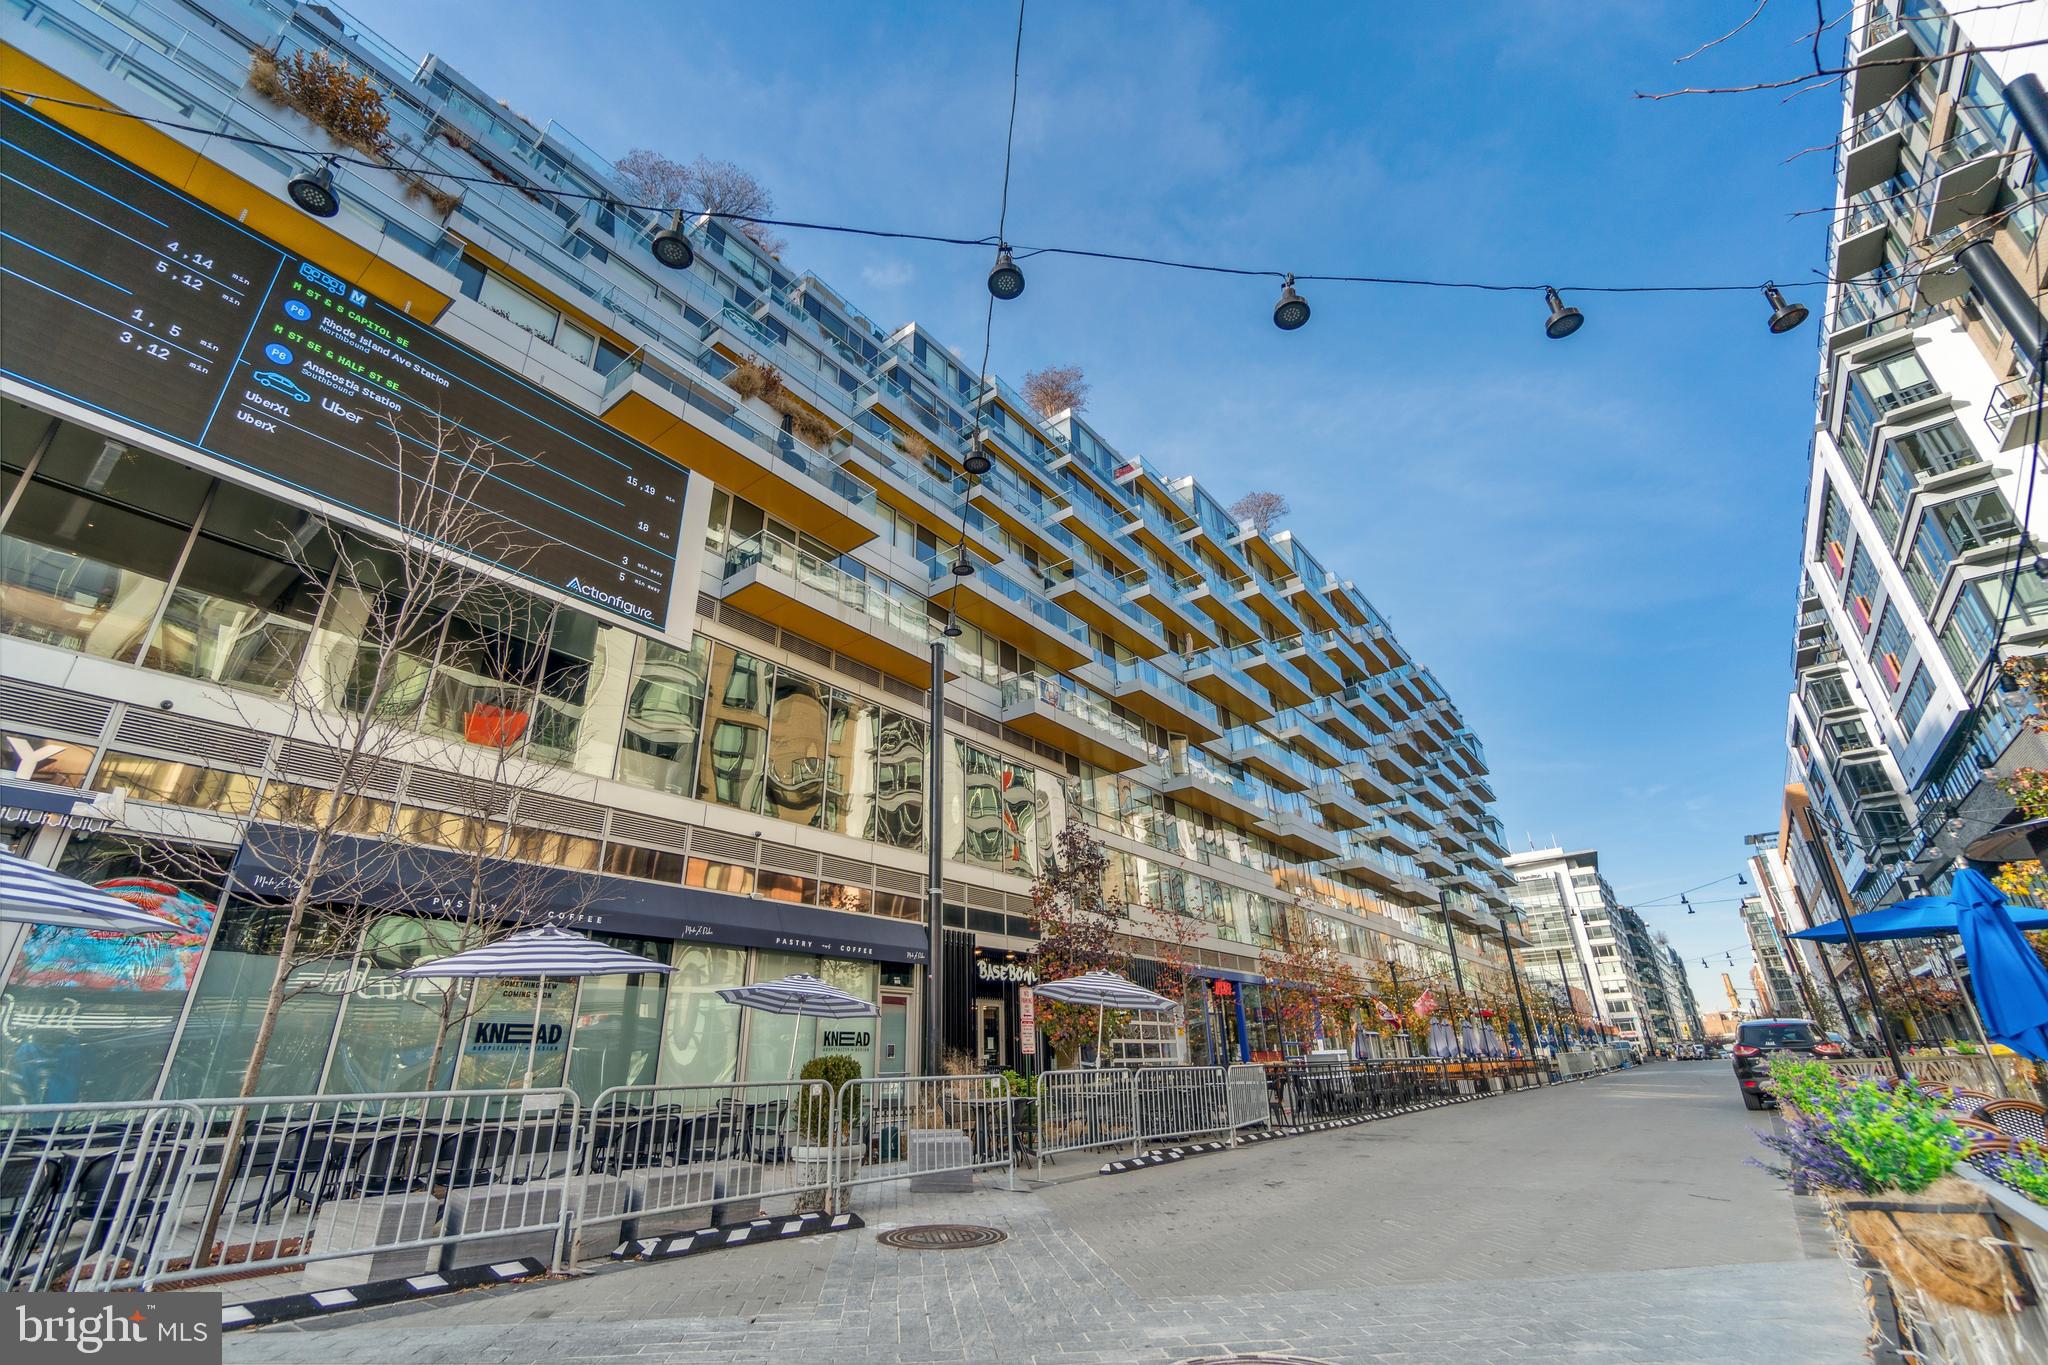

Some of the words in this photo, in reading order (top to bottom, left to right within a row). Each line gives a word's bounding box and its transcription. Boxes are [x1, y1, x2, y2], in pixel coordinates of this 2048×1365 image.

[231, 273, 250, 286] min
[221, 293, 241, 306] min
[293, 281, 302, 291] M
[306, 288, 321, 300] ST
[324, 298, 332, 307] &
[336, 305, 345, 313] S
[348, 311, 391, 339] CAPITOL
[396, 336, 410, 348] SE
[199, 339, 220, 352] min
[319, 325, 371, 354] Northbound
[271, 348, 287, 360] P6
[273, 324, 284, 334] M
[287, 331, 304, 343] ST
[306, 340, 322, 353] SE
[326, 350, 334, 359] &
[337, 355, 365, 373] HALF
[368, 371, 383, 382] ST
[385, 379, 400, 391] SE
[322, 316, 357, 340] Rhode
[359, 335, 391, 357] Island
[391, 353, 412, 368] Ave
[413, 363, 450, 388] Station
[188, 361, 209, 375] min
[301, 368, 355, 397] Southbound
[303, 360, 360, 392] Anacostia
[361, 387, 402, 412] Station
[245, 390, 291, 418] UberXL
[321, 397, 364, 424] Uber
[236, 410, 277, 434] UberX
[637, 521, 649, 532] 18
[621, 556, 629, 565] 3
[619, 572, 626, 582] 5
[566, 576, 653, 620] Actionfigure
[6, 735, 67, 781] Y
[432, 897, 498, 912] PASRY
[547, 911, 603, 924] COFFEE
[775, 937, 813, 948] PASTRY
[840, 945, 873, 955] COFFEE
[500, 980, 541, 989] SOMETHING
[503, 990, 531, 998] COMING
[533, 991, 553, 999] SON
[474, 1022, 563, 1044] KNEAD
[823, 1031, 871, 1046] KNEAD
